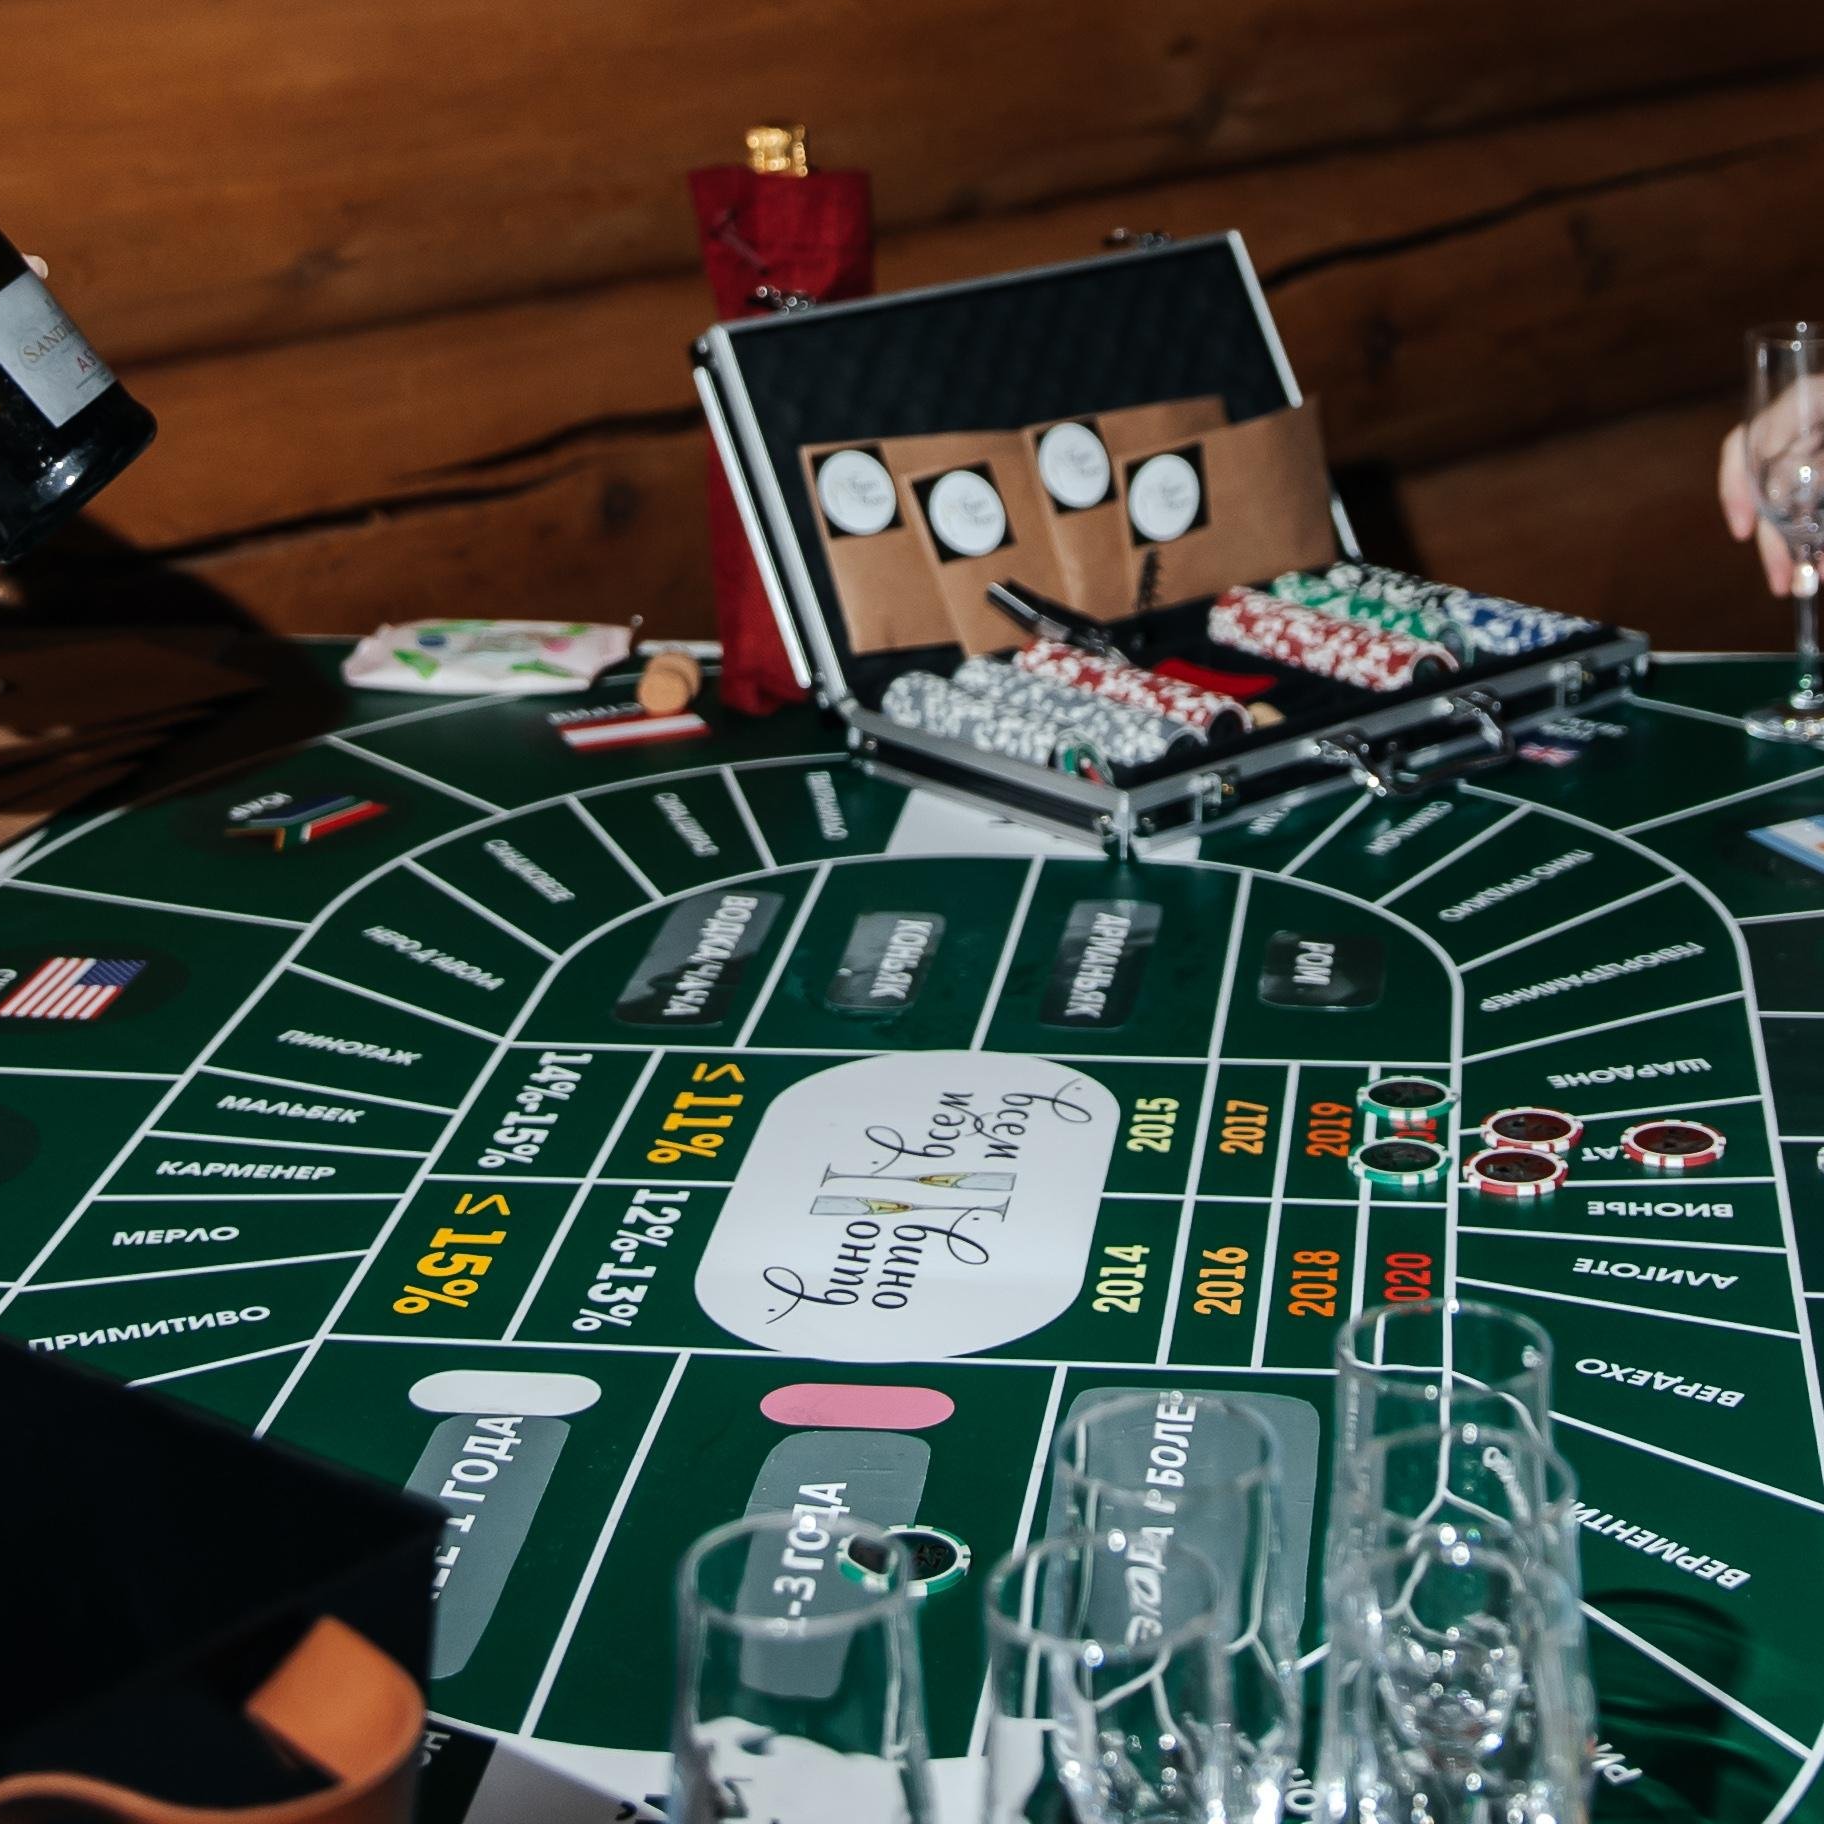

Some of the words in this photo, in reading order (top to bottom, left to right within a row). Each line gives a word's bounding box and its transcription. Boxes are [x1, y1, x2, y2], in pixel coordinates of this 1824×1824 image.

[662, 895, 759, 1017] ВОДКА/ЧАЧА
[869, 919, 934, 1001] КОНЬЯК
[1065, 913, 1132, 1019] АРМАНЬЯК
[1293, 941, 1336, 986] РОМ
[278, 1030, 422, 1067] ПИНОТАЖ
[1546, 1056, 1712, 1090] ШАРДОНЕ
[217, 1095, 366, 1124] МАЛЬБЕК
[477, 1052, 593, 1168] 14%-15%
[1127, 1096, 1179, 1153] 2015
[1220, 1100, 1269, 1155] 2017
[1306, 1102, 1353, 1158] 2019
[156, 1160, 336, 1181] КАРМЕНЕР
[112, 1226, 240, 1246] МЕРЛО
[1587, 1200, 1734, 1219] ВИОНЬЕ
[392, 1228, 507, 1314] 15%
[572, 1189, 690, 1331] 12%-13%
[1093, 1244, 1150, 1314] 2014
[1194, 1246, 1249, 1316] 2016
[1289, 1250, 1340, 1318] 2018
[1384, 1252, 1432, 1315] 020
[1572, 1257, 1739, 1292] АЛИГОТЕ
[28, 1306, 271, 1353] ПРИМИТИВО
[1574, 1357, 1745, 1409] ВЕРДЕХО
[440, 1416, 524, 1503] ГОДА
[1569, 1498, 1752, 1591] ВЕРМЕНТИ
